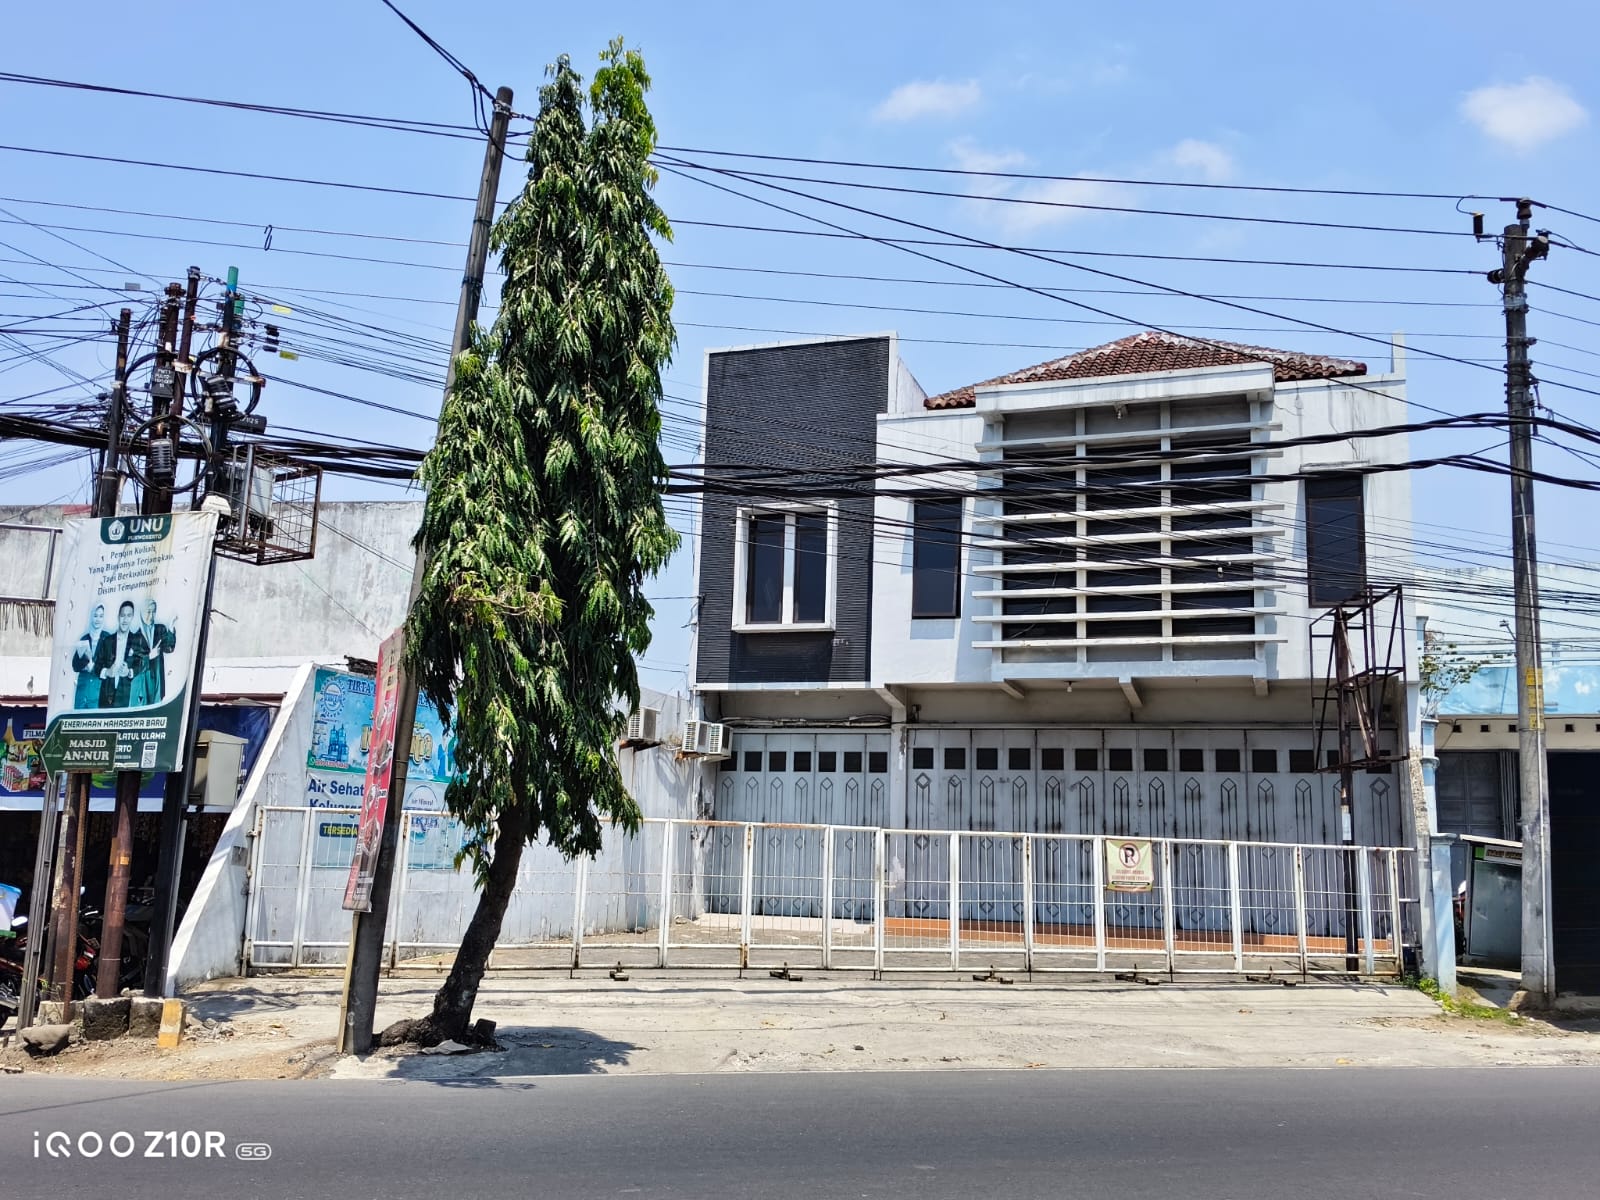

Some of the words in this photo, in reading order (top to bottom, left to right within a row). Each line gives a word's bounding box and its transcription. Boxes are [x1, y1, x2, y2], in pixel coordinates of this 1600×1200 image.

[130, 517, 164, 533] UNU
[110, 550, 133, 560] Pengin
[88, 566, 105, 575] Yang
[103, 575, 117, 585] Tapi
[97, 586, 116, 596] Disini
[347, 679, 371, 694] TIRTA
[103, 719, 145, 728] MAHASISWA
[146, 718, 165, 727] BARU
[141, 732, 166, 740] ULAMA
[69, 740, 107, 748] MASJID
[62, 751, 110, 761] AN-NUR
[308, 779, 327, 793] Air
[330, 780, 364, 796] Sehat
[323, 826, 358, 836] TERSEDIA
